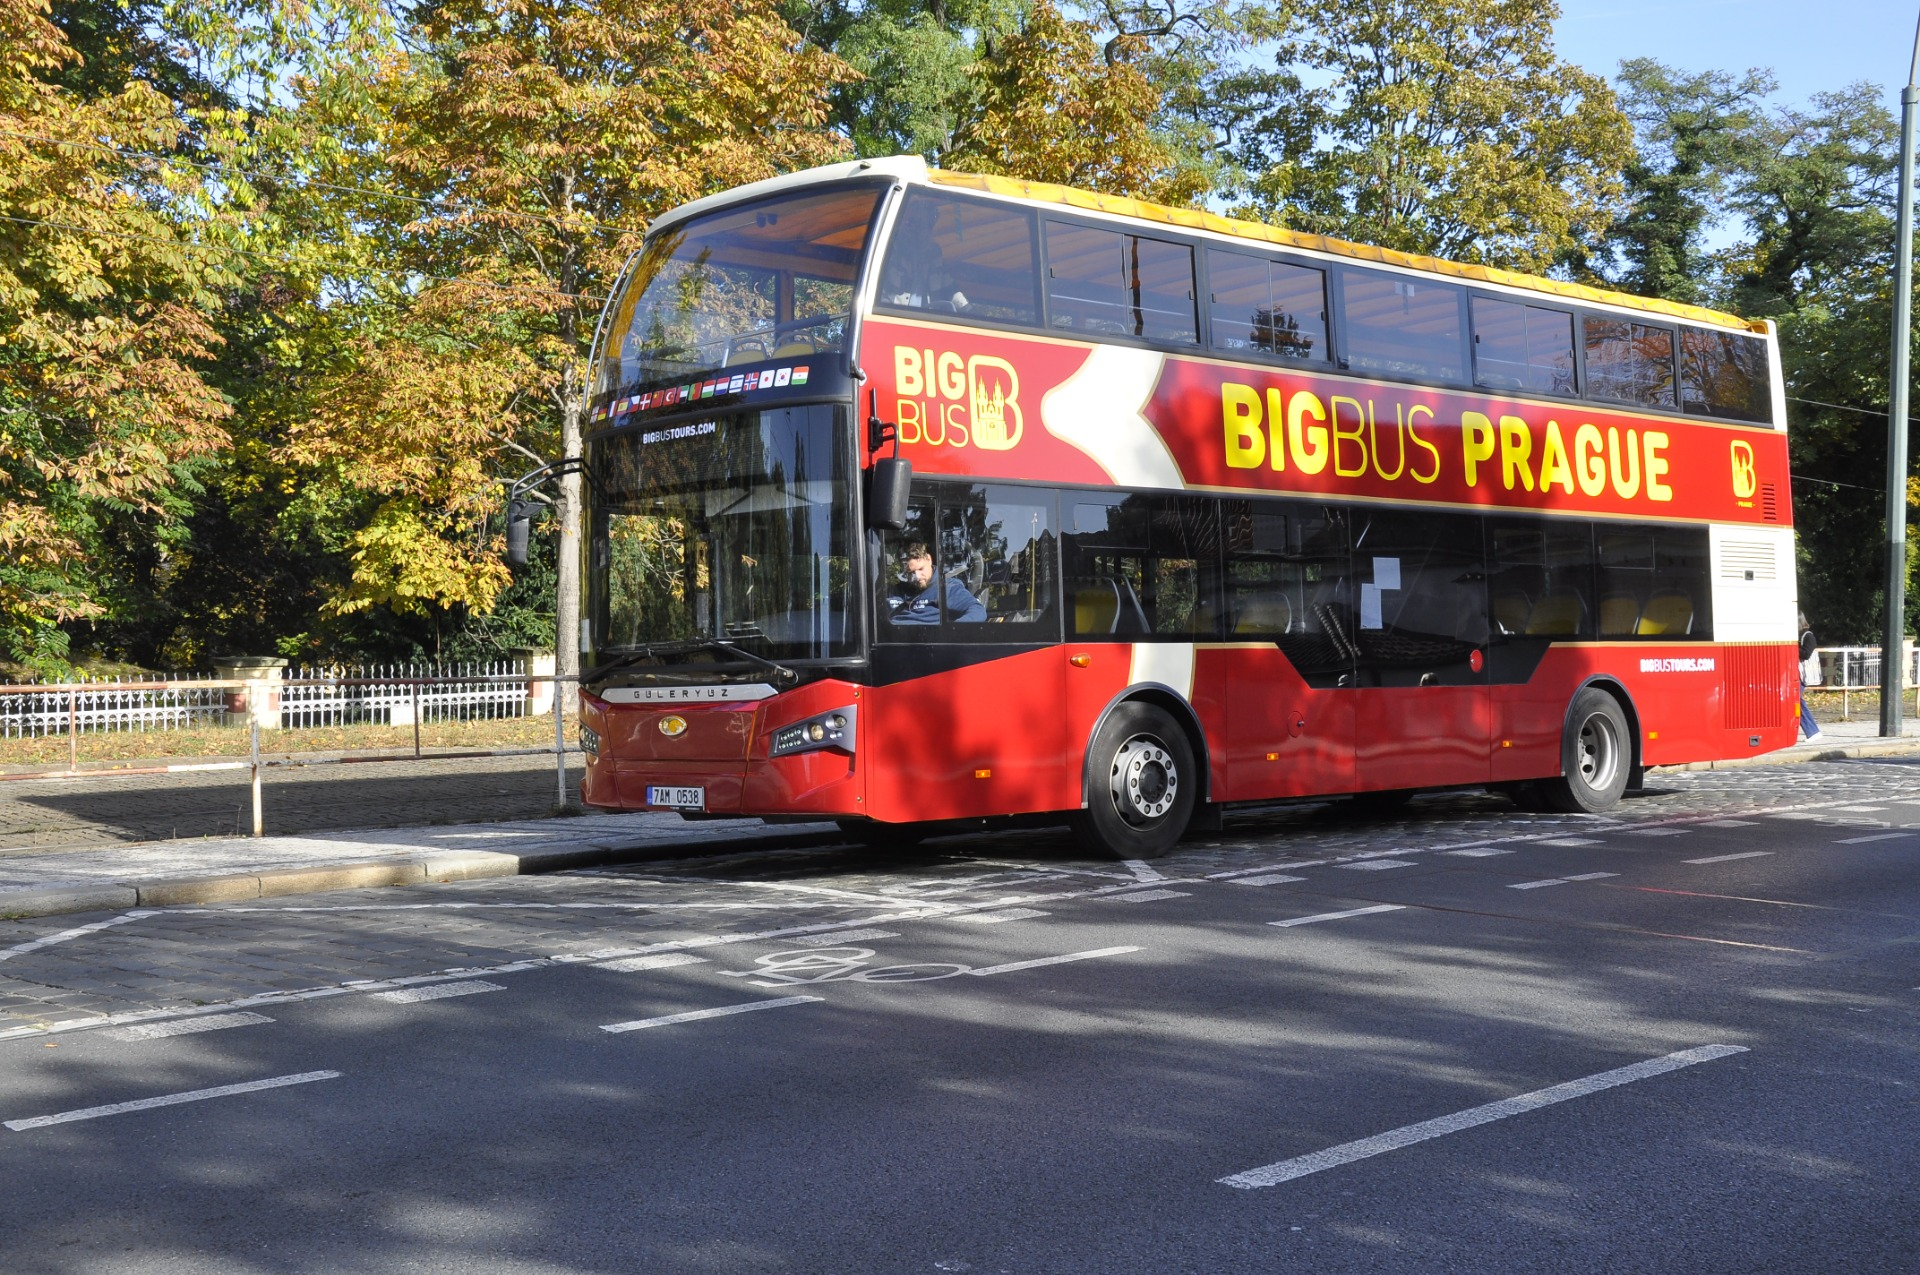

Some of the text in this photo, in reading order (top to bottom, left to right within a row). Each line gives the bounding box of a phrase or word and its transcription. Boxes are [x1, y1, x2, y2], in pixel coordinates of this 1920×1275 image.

[894, 345, 967, 401] BIG
[642, 421, 716, 445] BIGBUSTOURS.COM
[897, 398, 970, 448] BUS
[1221, 381, 1673, 502] BIGBUS PRAGUE
[1639, 657, 1715, 673] BIGBUSTOURS.COM
[653, 788, 699, 805] 7AM 0538
